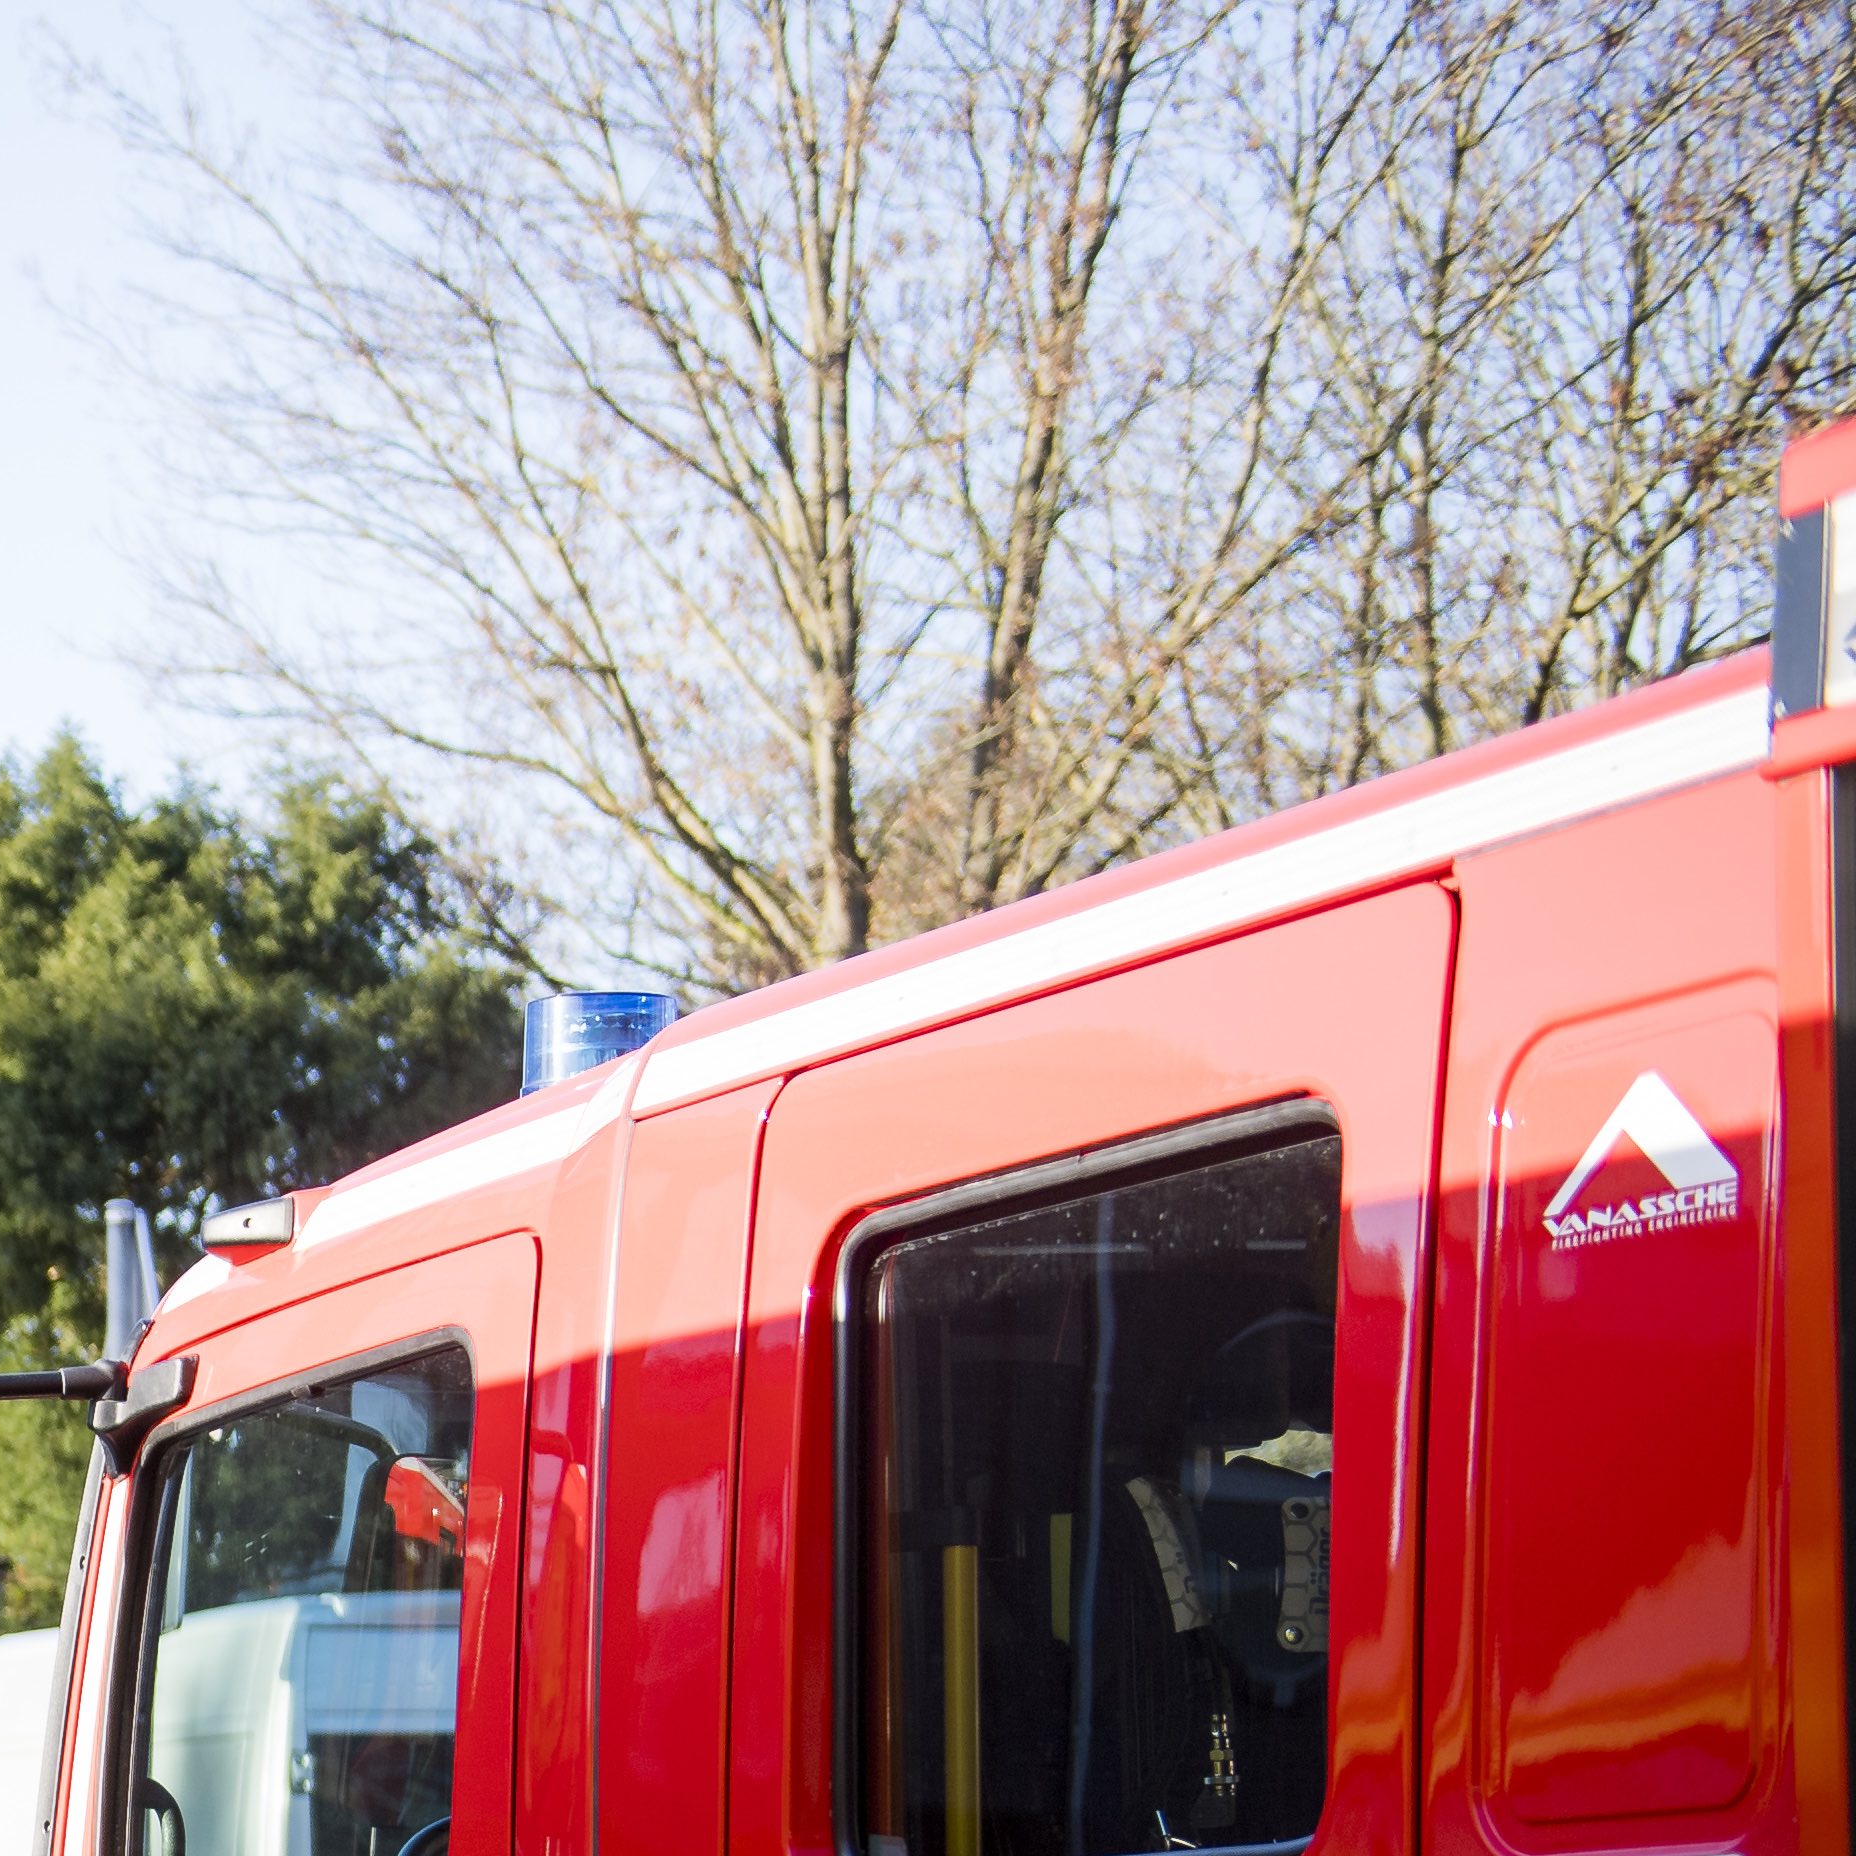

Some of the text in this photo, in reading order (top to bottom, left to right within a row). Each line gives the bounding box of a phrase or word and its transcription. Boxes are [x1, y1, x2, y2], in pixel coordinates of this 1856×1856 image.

[1542, 1182, 1738, 1237] VANASSCHE
[1551, 1204, 1737, 1250] FIREFIGHTING ENGINEERING
